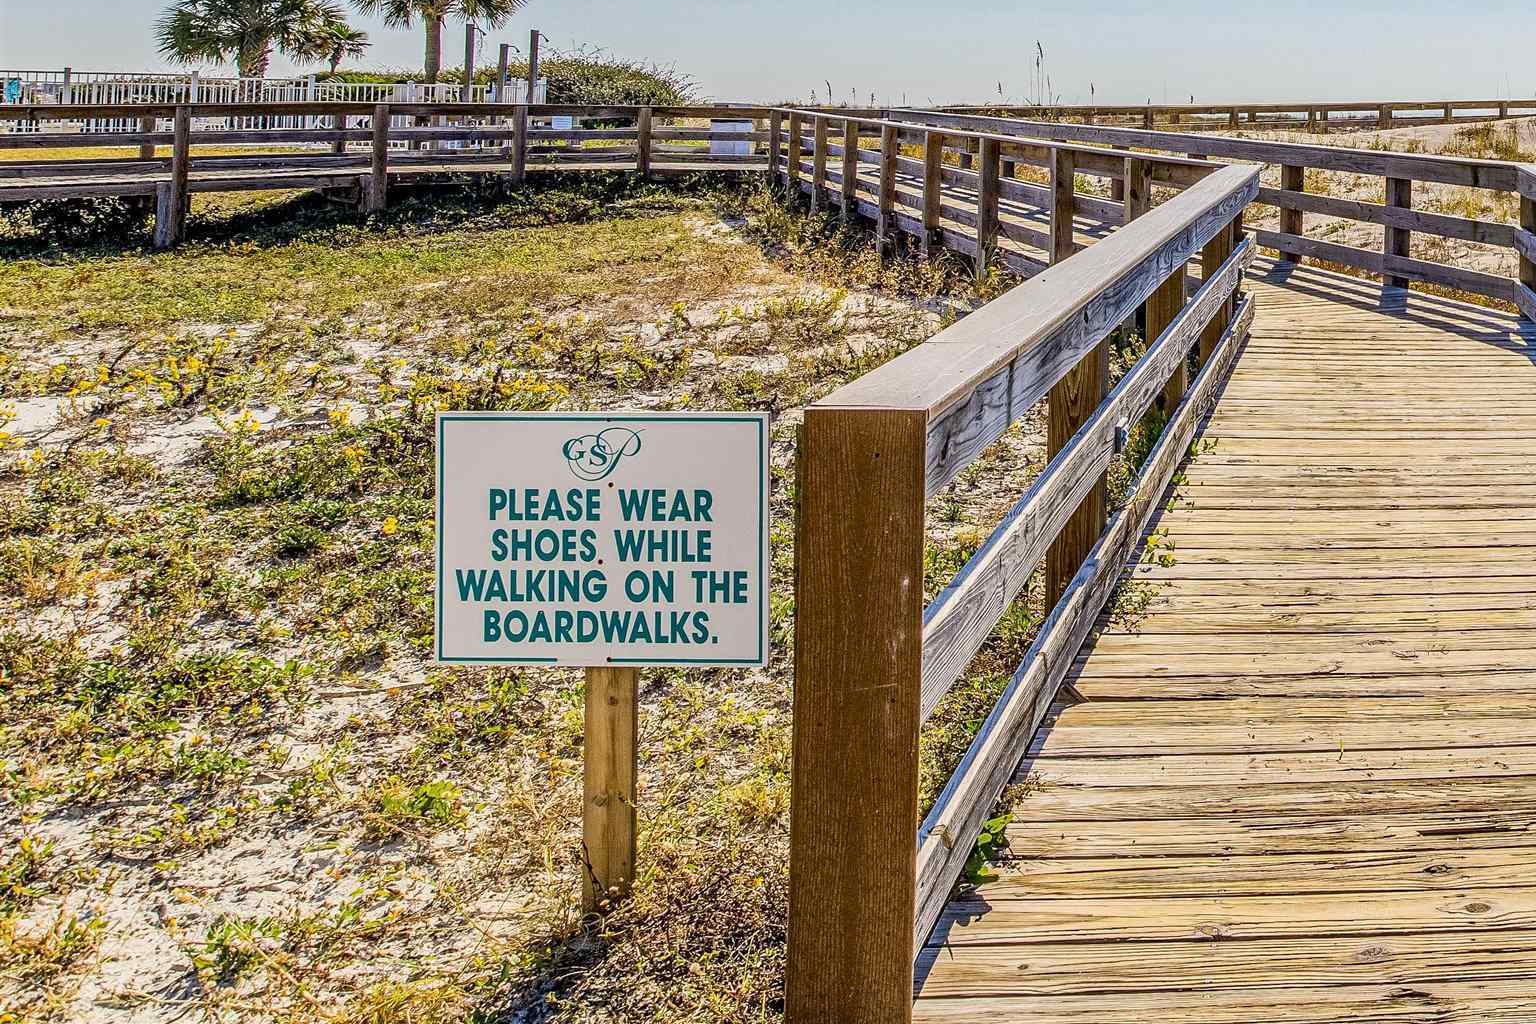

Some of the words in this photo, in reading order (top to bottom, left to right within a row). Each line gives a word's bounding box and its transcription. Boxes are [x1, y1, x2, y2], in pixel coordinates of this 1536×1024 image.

[489, 489, 600, 521] PLEASE
[618, 489, 713, 521] WEAR
[491, 529, 597, 562] SHOES
[614, 530, 712, 562] WHILE
[456, 569, 608, 603] WALKING
[624, 570, 674, 603] ON
[691, 571, 748, 603] THE
[483, 610, 718, 644] BOARDWALKS.
